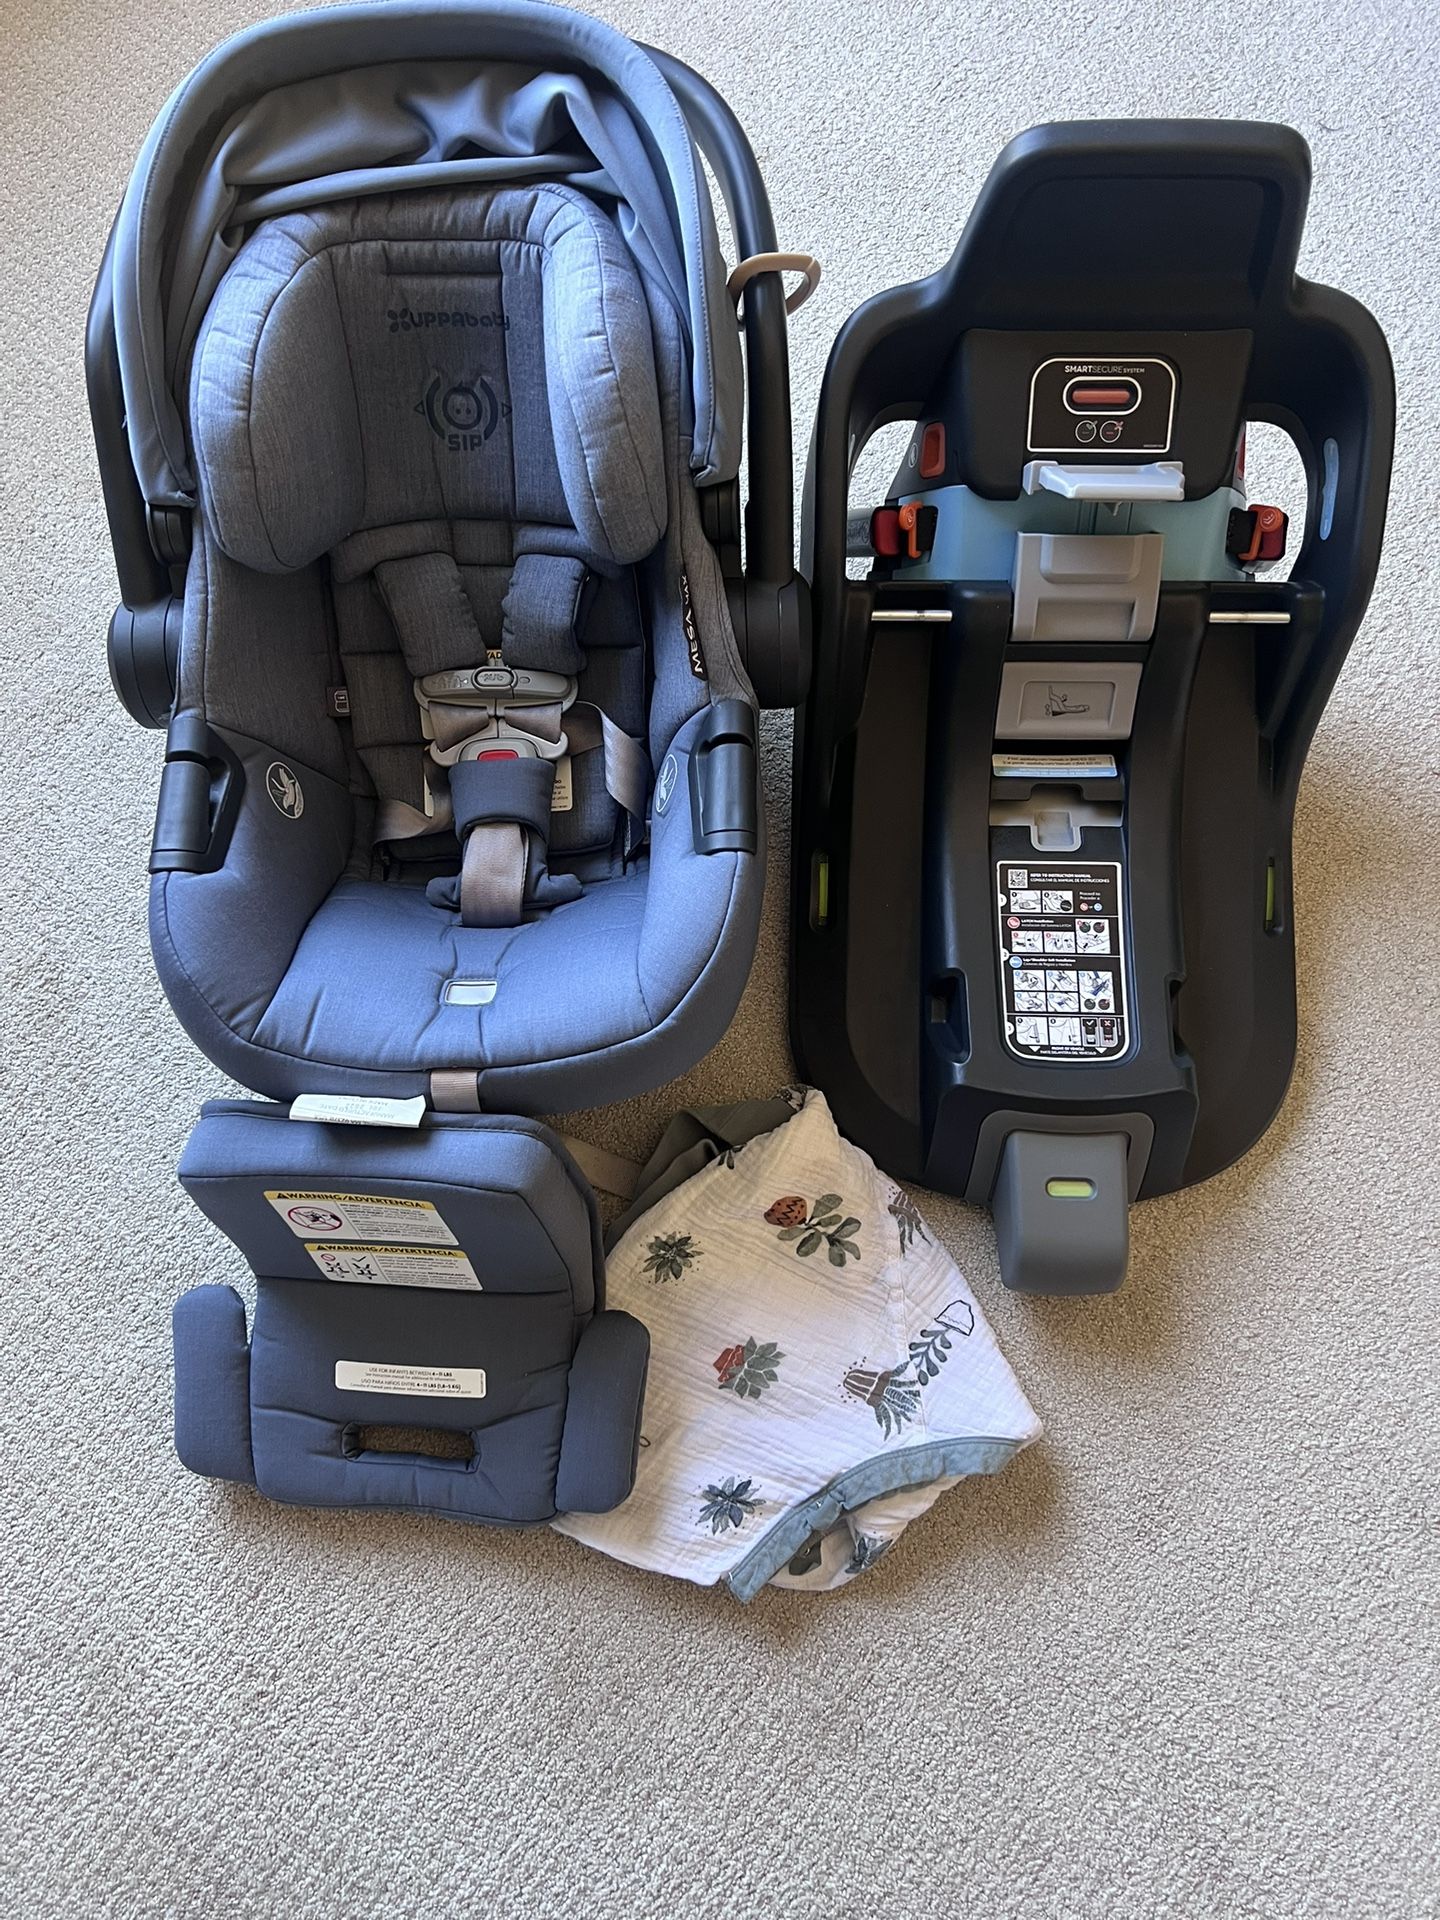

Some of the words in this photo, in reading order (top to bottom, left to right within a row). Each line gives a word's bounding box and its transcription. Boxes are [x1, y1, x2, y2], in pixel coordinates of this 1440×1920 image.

[410, 311, 510, 331] UPPAbaby
[1064, 365, 1123, 374] SMARTSECURE
[447, 434, 482, 451] SIP
[685, 608, 704, 674] MESA
